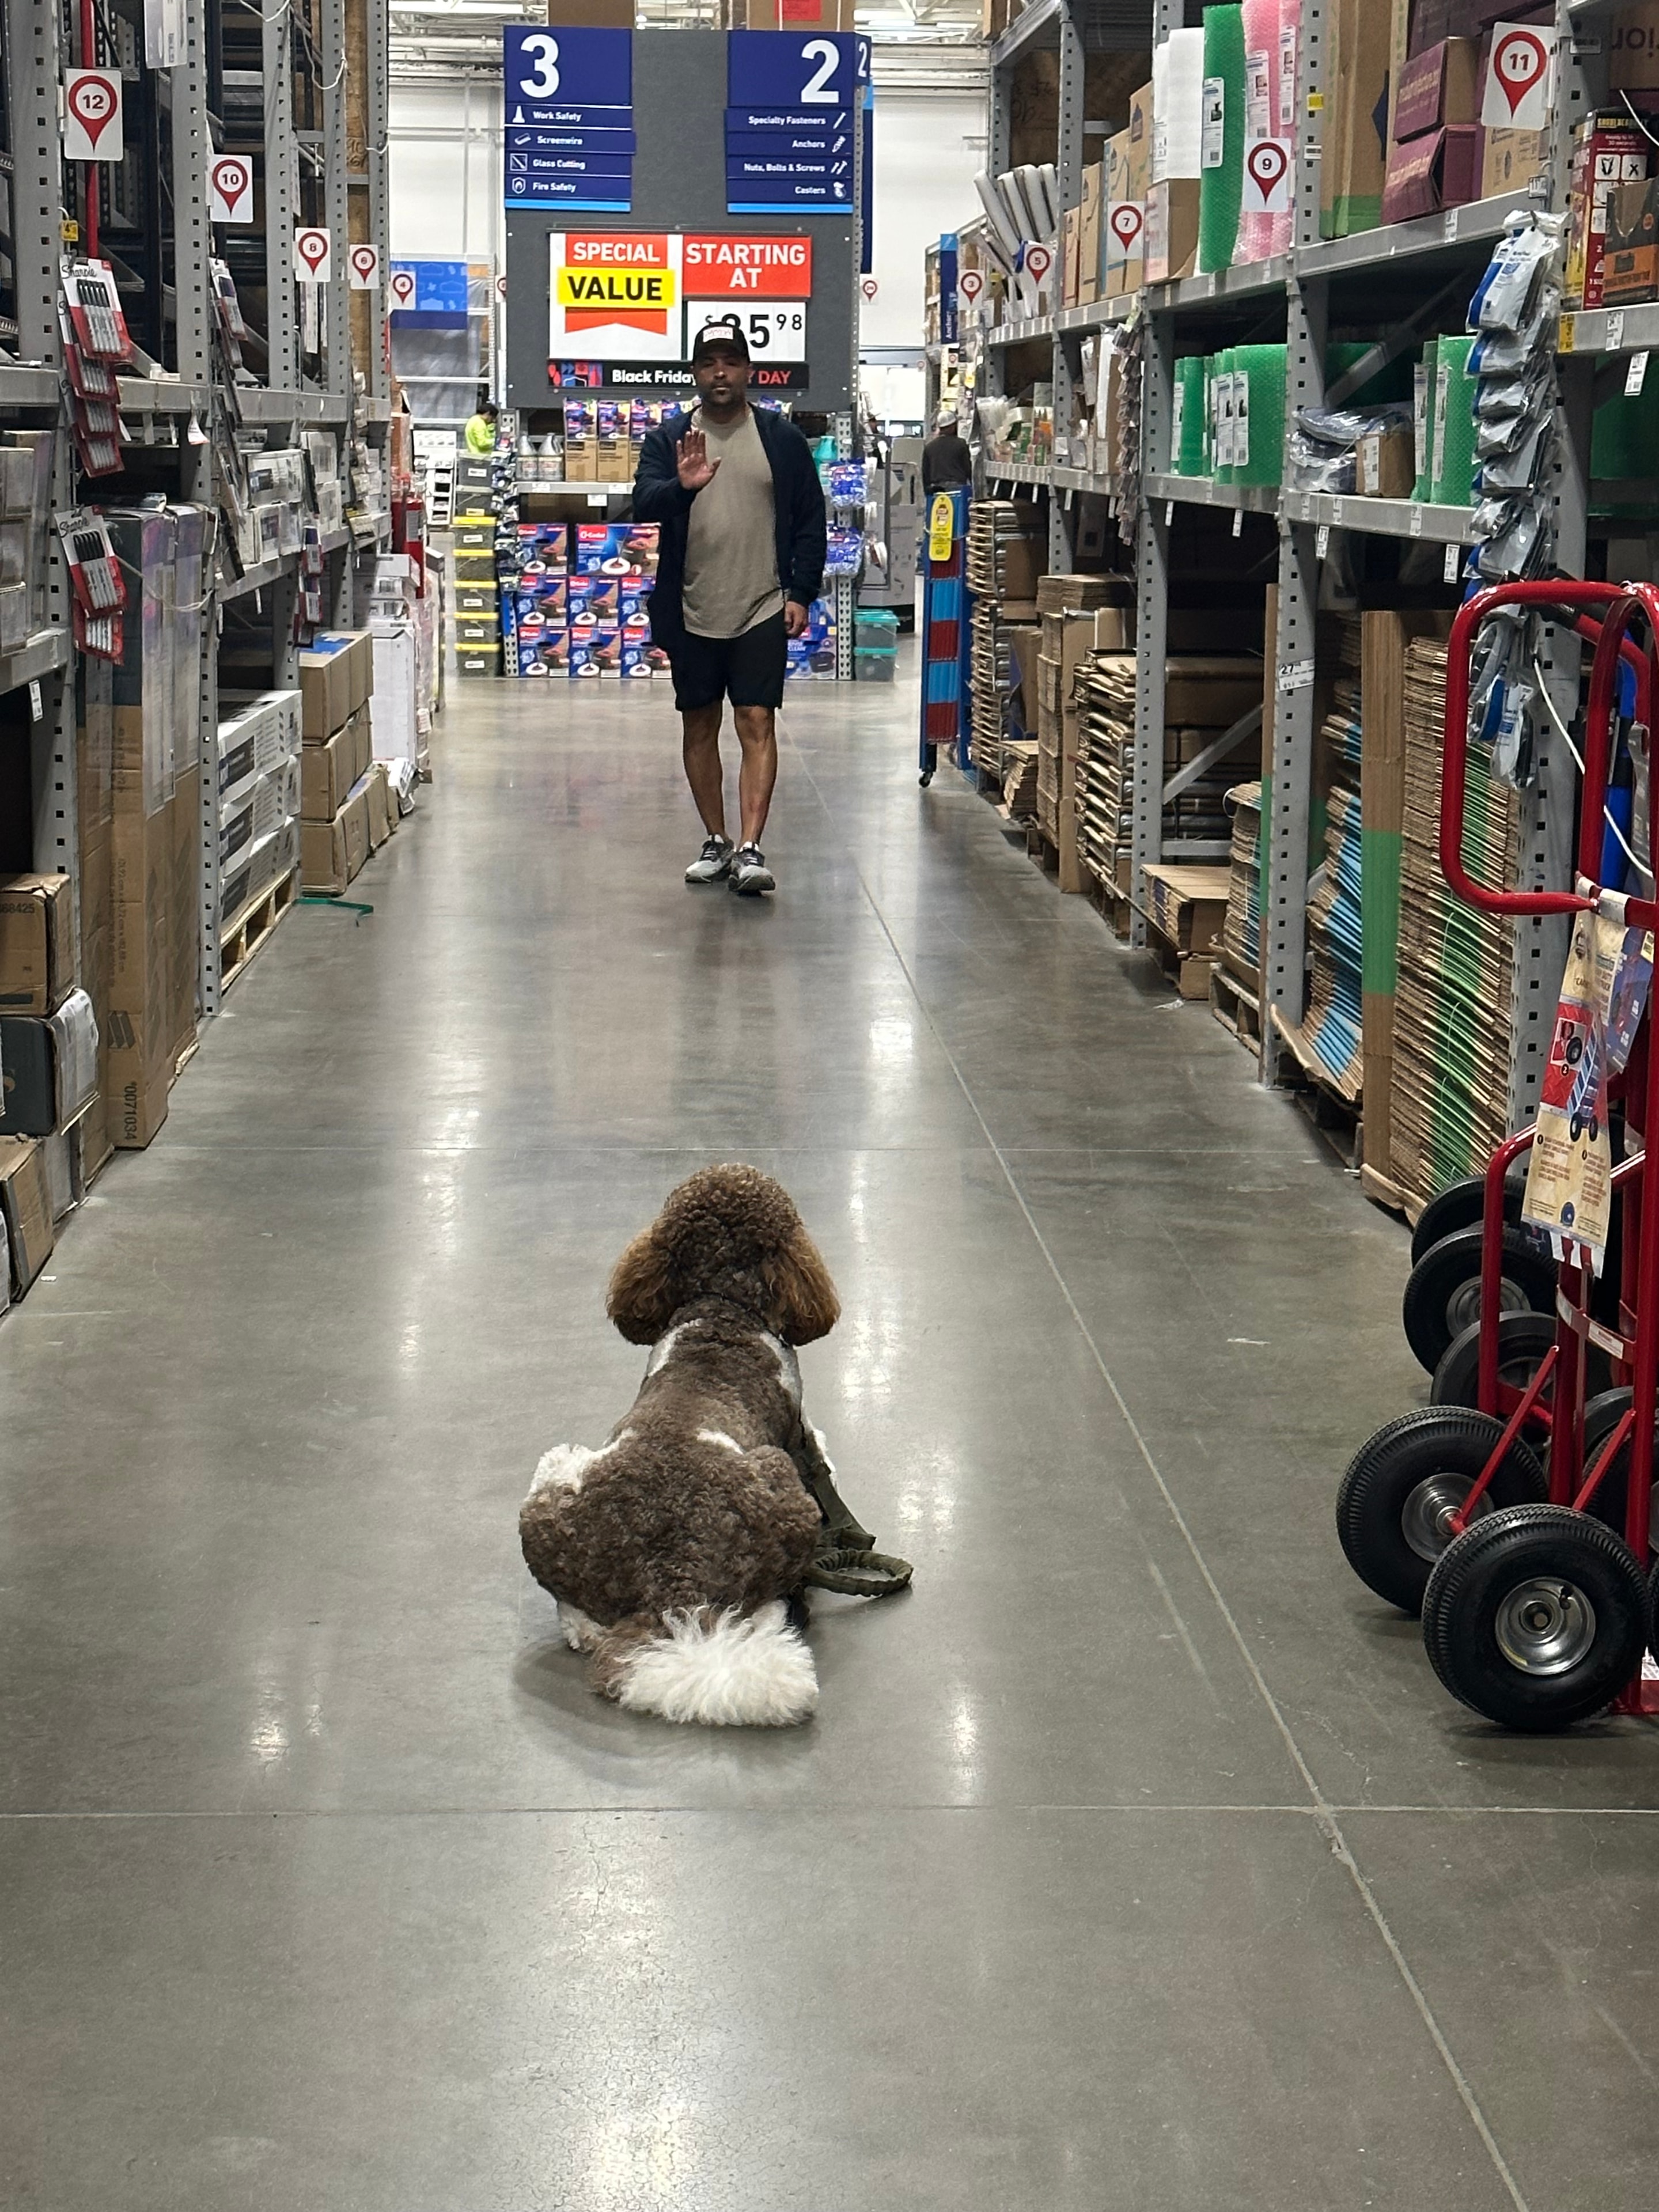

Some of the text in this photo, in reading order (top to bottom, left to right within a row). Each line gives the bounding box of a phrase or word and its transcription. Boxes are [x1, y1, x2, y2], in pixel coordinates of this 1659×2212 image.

[858, 41, 867, 77] 2
[1509, 53, 1529, 71] 11
[520, 34, 559, 98] 3
[801, 39, 839, 103] 2
[82, 94, 104, 109] 12
[533, 111, 581, 122] Work Safety
[748, 116, 826, 126] Specialty Fasteners
[792, 140, 825, 148] Anchors
[533, 159, 585, 170] Glass Cutting
[744, 163, 764, 172] Nuts,
[766, 164, 787, 172] Bolts
[796, 164, 825, 172] Screws
[1262, 158, 1272, 170] 9
[222, 173, 239, 185] 10
[550, 183, 576, 193] Safety
[795, 186, 825, 194] Casters
[1123, 218, 1130, 227] 7
[309, 243, 317, 252] 8
[573, 243, 661, 263] SPECIAL
[685, 244, 806, 266] STARTING
[729, 268, 762, 288] AT
[567, 275, 662, 301] VALUE
[777, 313, 802, 330] 98
[612, 369, 652, 383] Black
[758, 370, 791, 385] DAY
[0, 903, 35, 914] 68425
